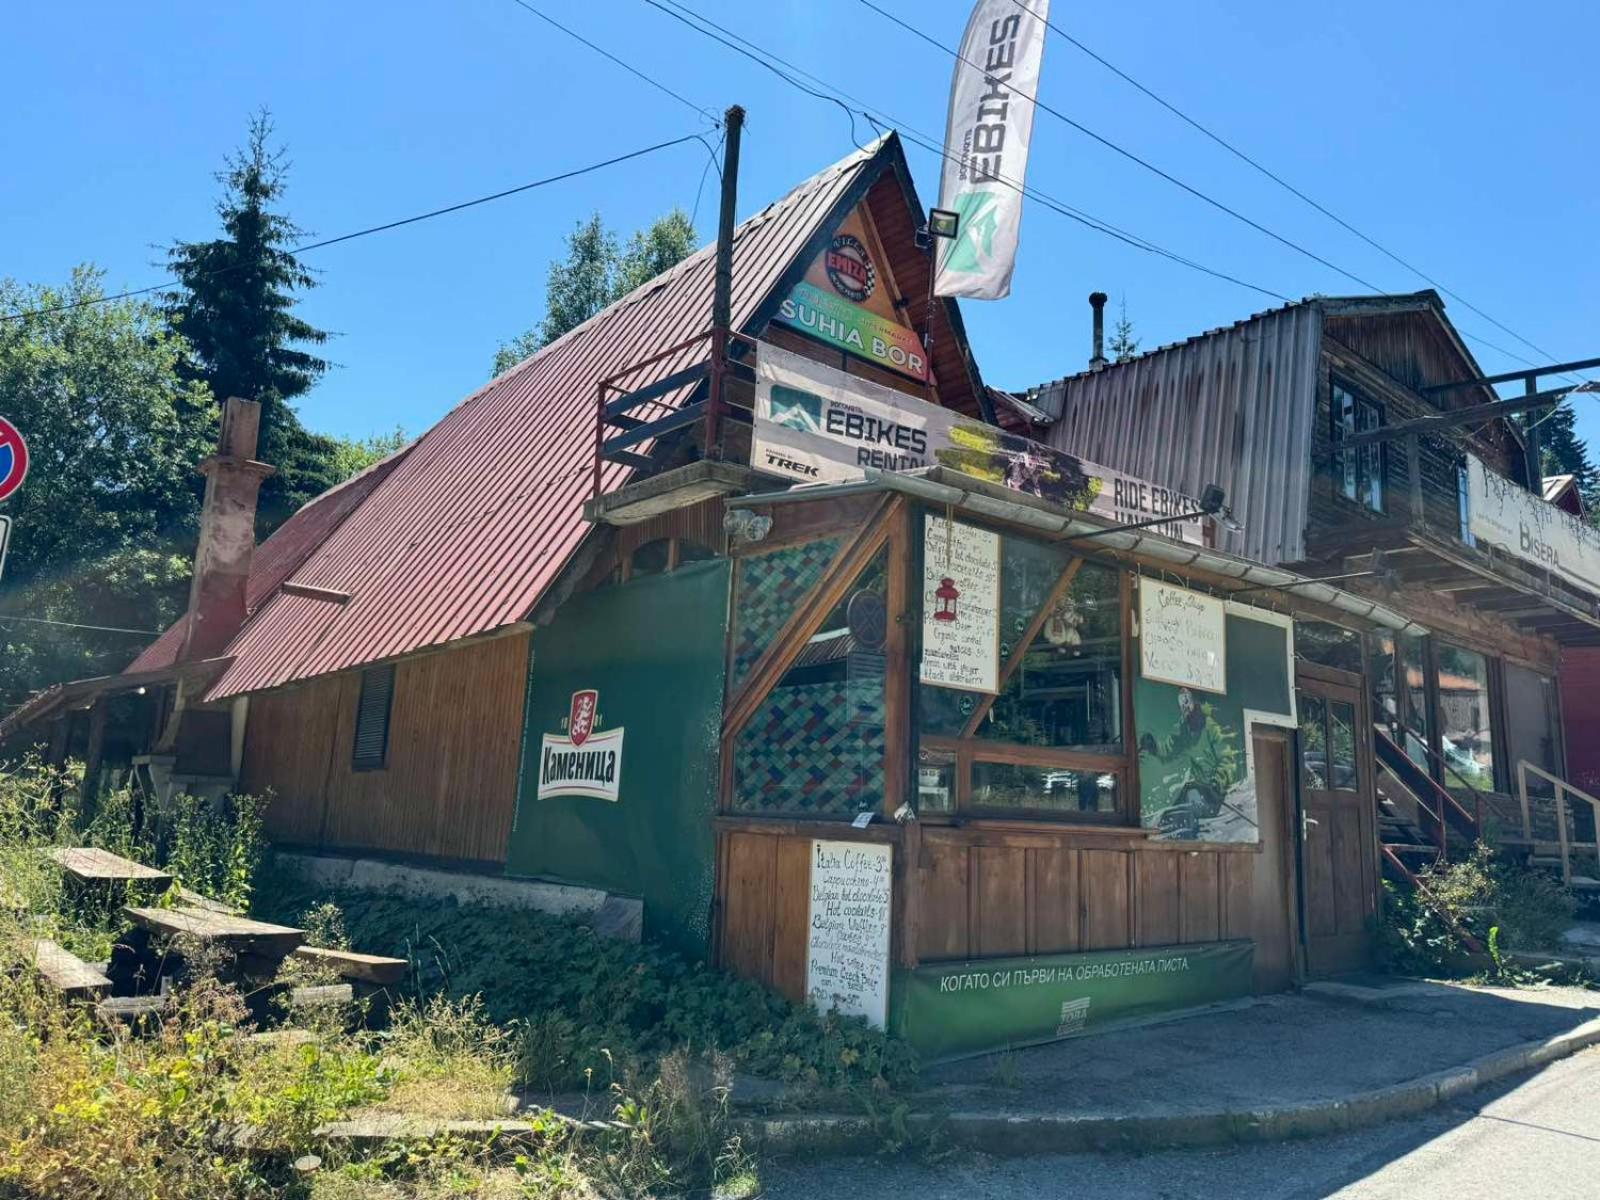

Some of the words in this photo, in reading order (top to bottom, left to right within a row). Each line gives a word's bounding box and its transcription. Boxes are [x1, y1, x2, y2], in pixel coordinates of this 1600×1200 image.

[969, 14, 1021, 184] EBIKES
[780, 299, 865, 349] SUHIA
[872, 336, 923, 374] BOR
[827, 409, 927, 454] EBIKES
[766, 454, 819, 478] TREK
[857, 446, 928, 471] RENTA
[1114, 478, 1148, 512] RIDE
[1151, 487, 1200, 523] EBIKES
[542, 747, 616, 787] Каменица
[940, 972, 990, 992] КОГАТО
[992, 971, 1010, 988] СИ
[1013, 968, 1055, 985] ПЪРВИ
[1058, 967, 1074, 982] НА
[1075, 960, 1157, 980] ОБРАБОТЕНАТА
